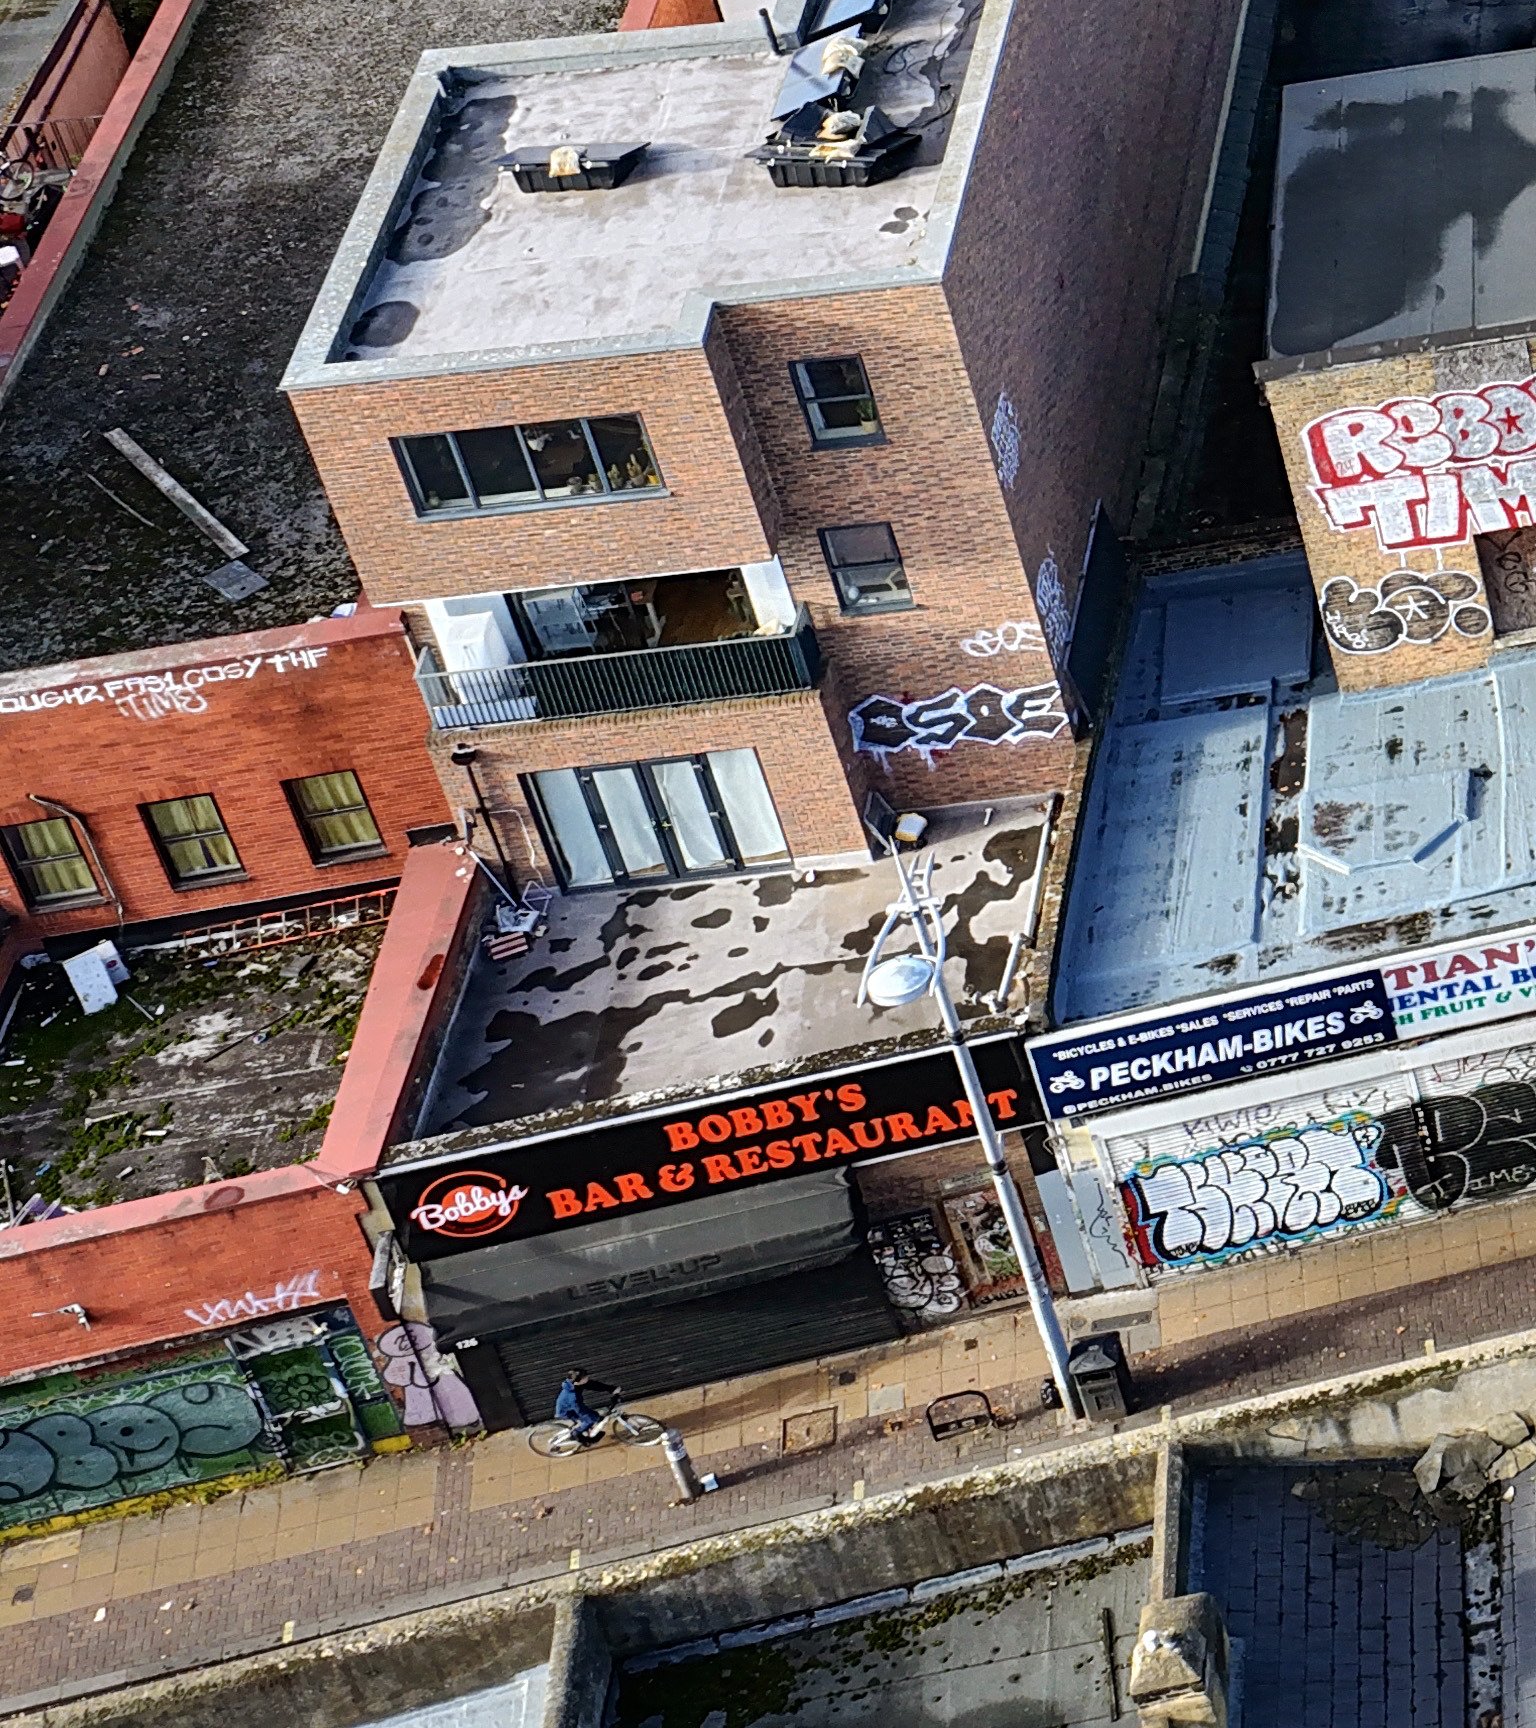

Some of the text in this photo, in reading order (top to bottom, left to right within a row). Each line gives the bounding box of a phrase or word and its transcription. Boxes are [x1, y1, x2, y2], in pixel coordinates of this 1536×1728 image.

[1421, 994, 1488, 1023] FRUIT
[1496, 990, 1512, 1004] &
[1088, 1010, 1347, 1092] PECKHAM-BIKES
[1117, 1035, 1127, 1048] &
[1128, 1024, 1176, 1046] E-BIKES
[1303, 1043, 1336, 1059] 727
[664, 1084, 868, 1154] BOBBY'S
[546, 1086, 1018, 1220] BAR & RESTAURANT
[410, 1184, 530, 1231] Bobby's
[570, 1253, 722, 1301] LEVEL-UP
[455, 1337, 479, 1350] 126
